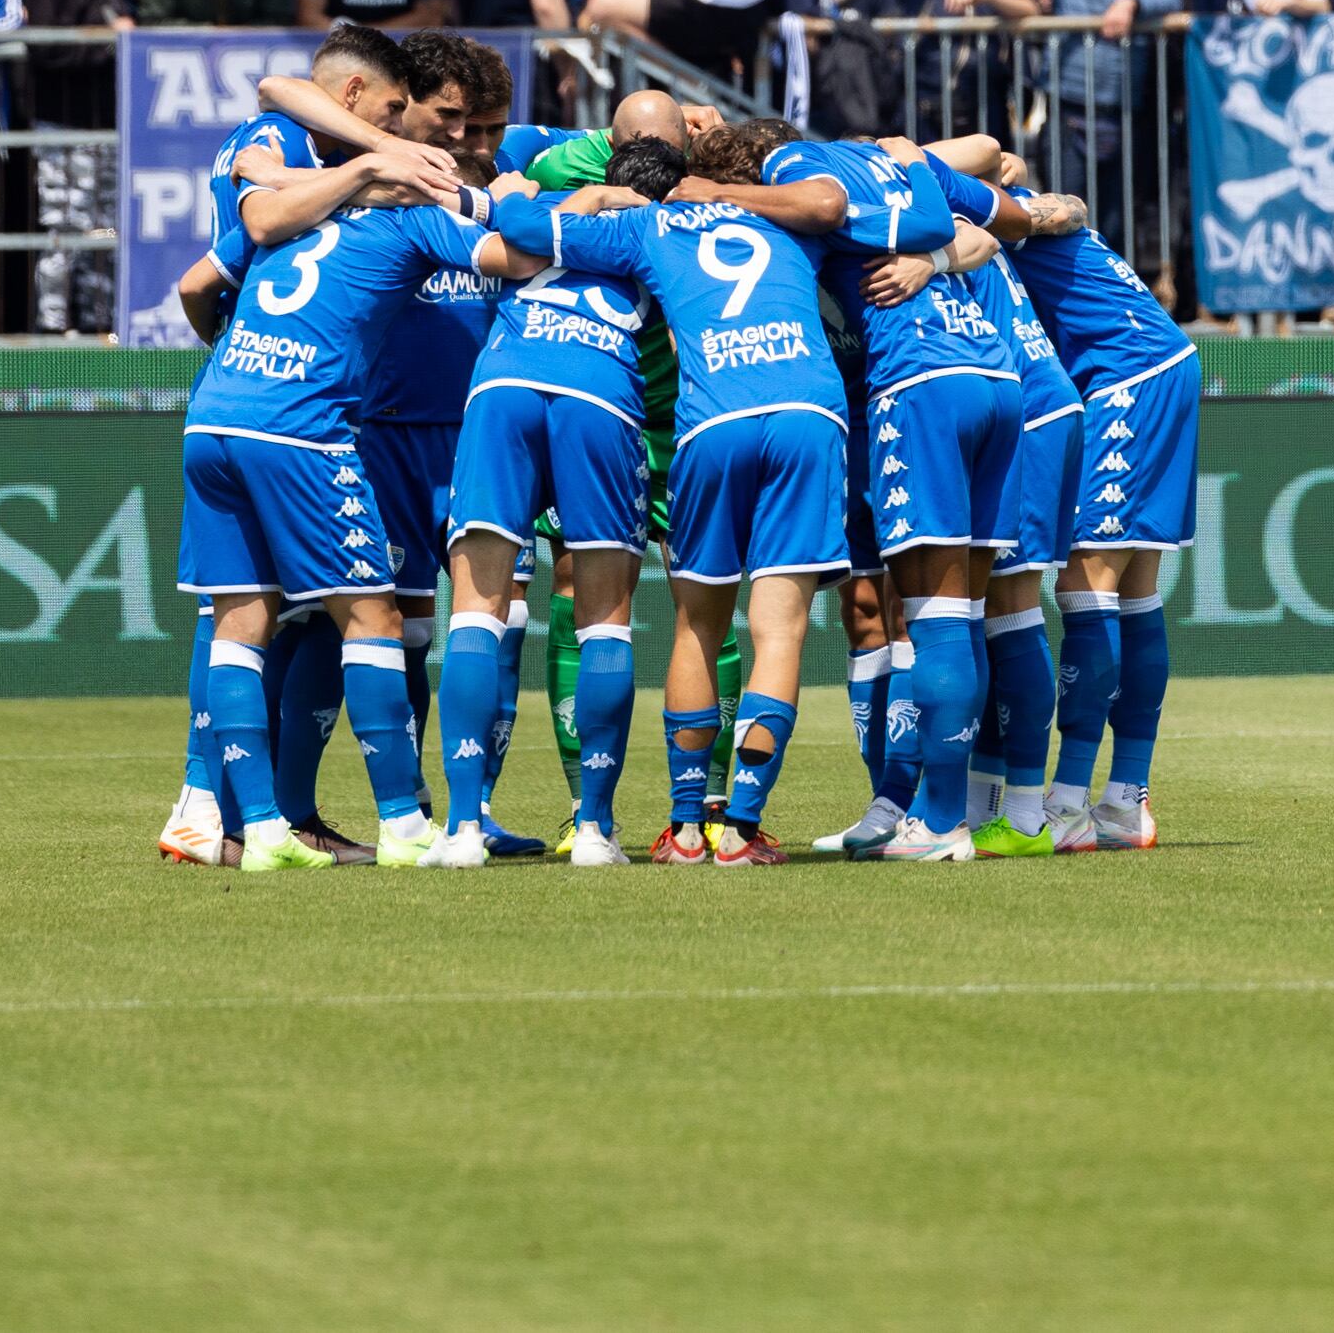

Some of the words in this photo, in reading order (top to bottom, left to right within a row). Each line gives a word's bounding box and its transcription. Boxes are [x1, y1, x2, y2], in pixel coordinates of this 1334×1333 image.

[257, 219, 341, 316] 3
[697, 224, 772, 320] 9
[521, 325, 620, 357] D'ITALIA
[526, 307, 625, 347] STAGIONI
[702, 321, 805, 355] STAGIONI
[230, 328, 317, 363] STAGIONI
[704, 337, 811, 374] D'ITALIA
[222, 346, 306, 382] D'ITALIA
